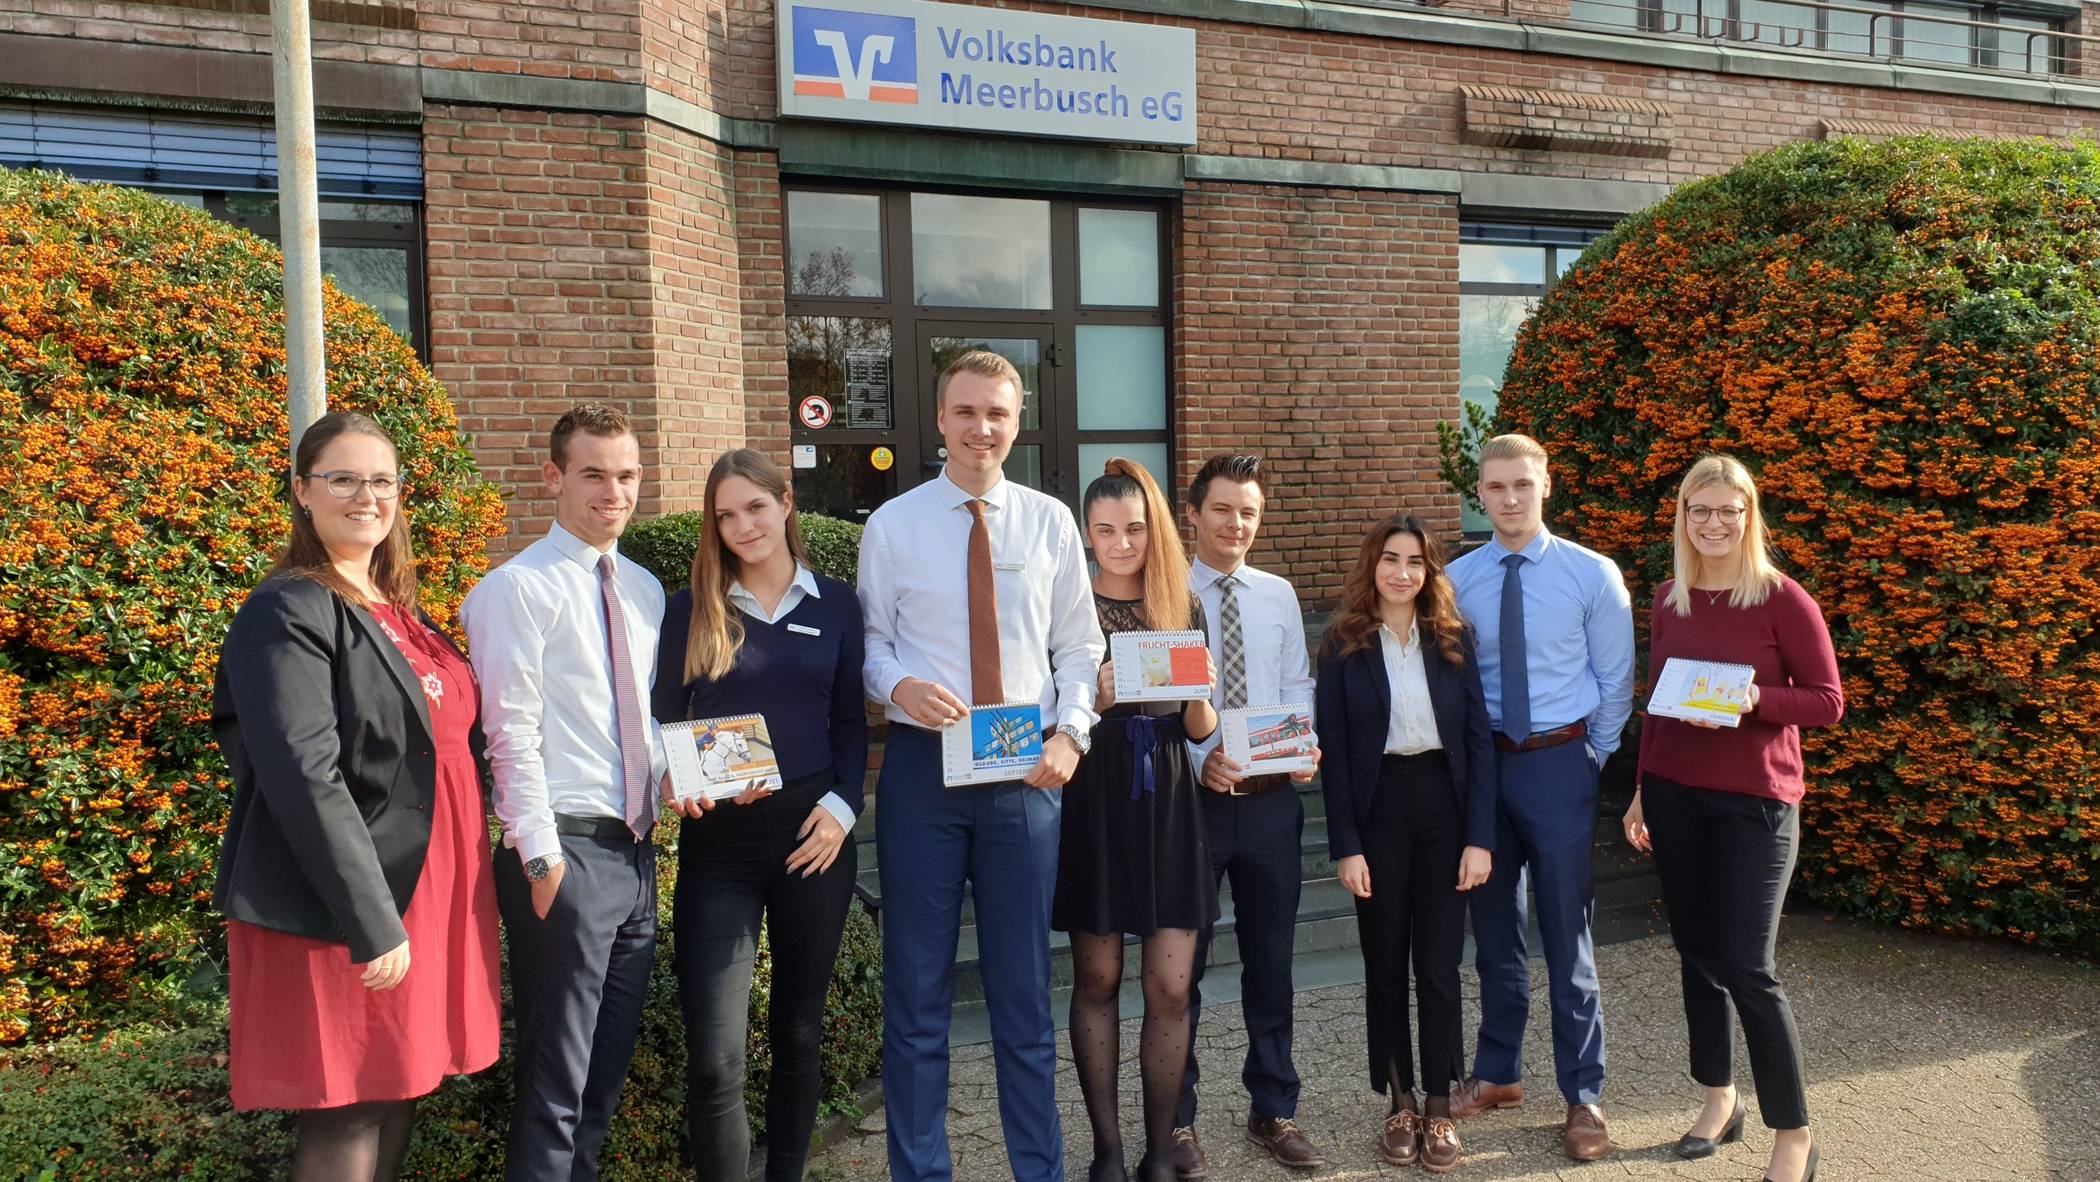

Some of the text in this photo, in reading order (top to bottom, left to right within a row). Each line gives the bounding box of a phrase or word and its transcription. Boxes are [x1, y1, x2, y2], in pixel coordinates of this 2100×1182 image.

[937, 26, 1118, 73] Volksbank
[940, 72, 1184, 122] Meerbusch eG
[1138, 640, 1205, 649] FRUCHT-SHAKER
